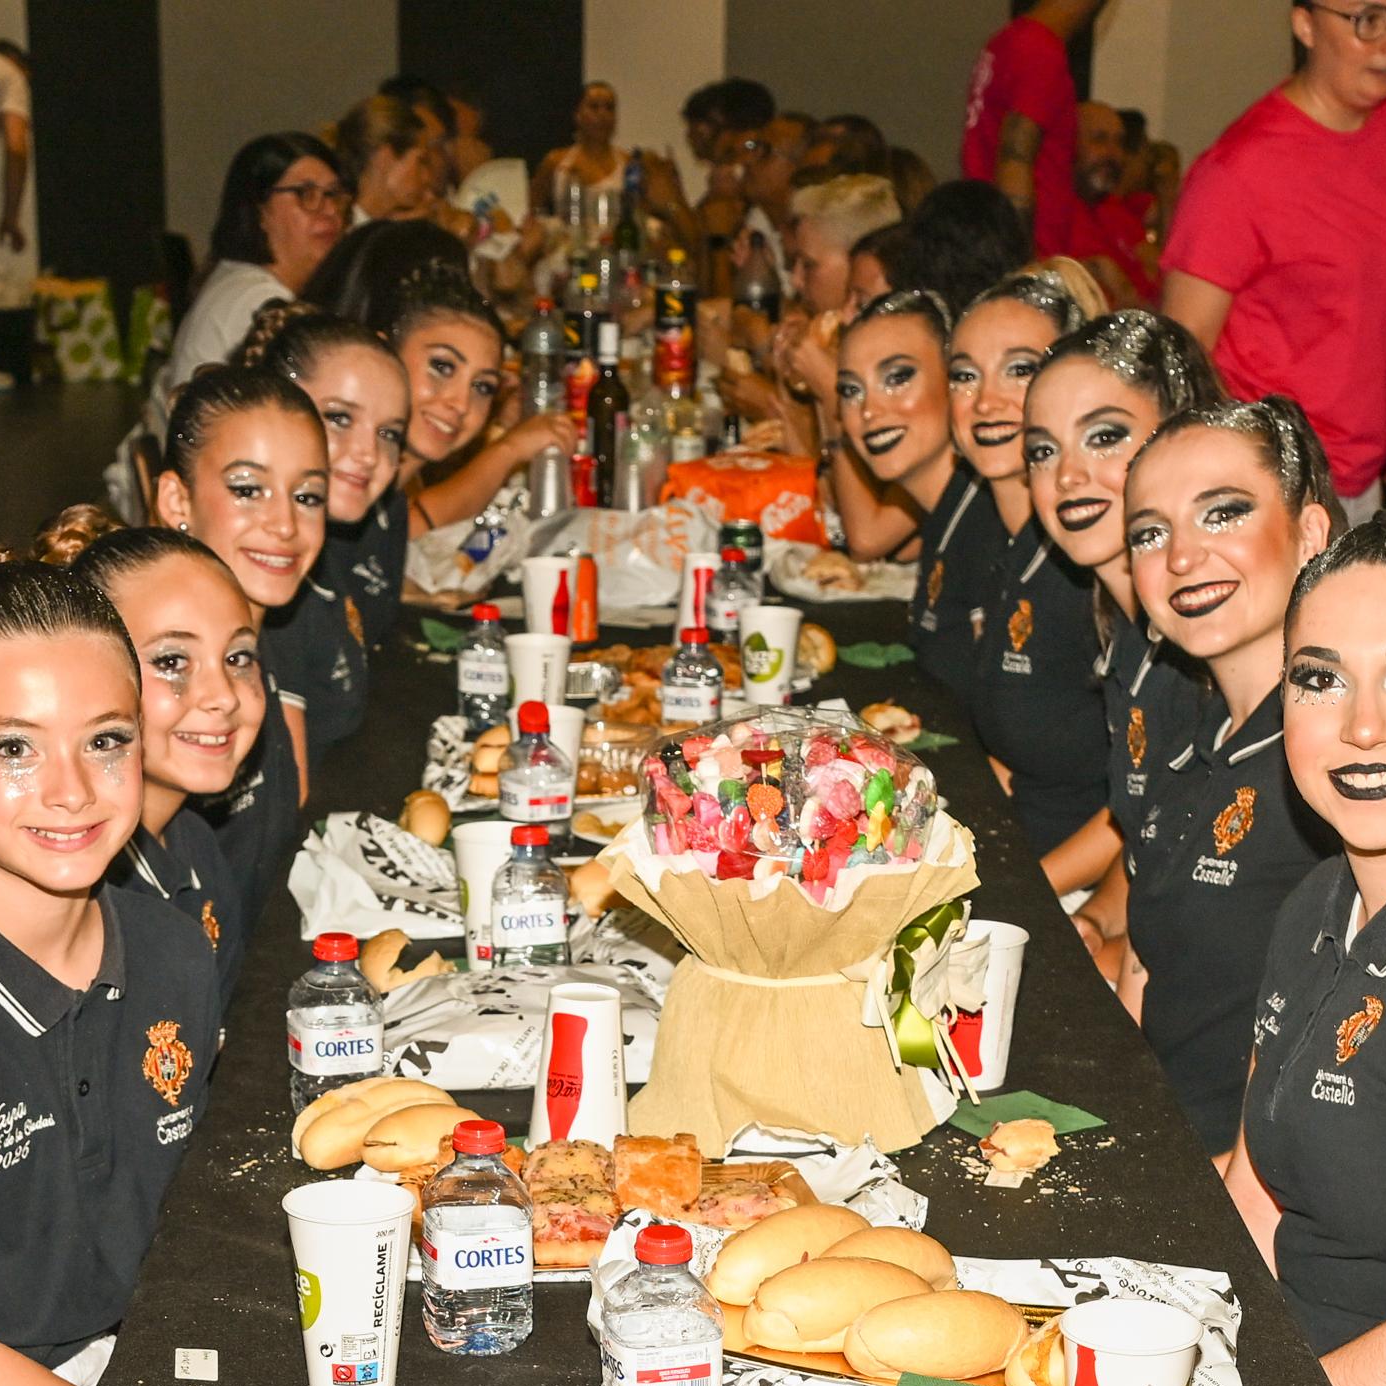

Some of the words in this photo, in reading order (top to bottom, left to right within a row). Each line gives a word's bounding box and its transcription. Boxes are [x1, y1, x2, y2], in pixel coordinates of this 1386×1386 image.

[501, 913, 554, 931] CORTES
[315, 1038, 375, 1057] CORTES
[455, 1246, 525, 1269] CORTES
[373, 1243, 388, 1328] RECÍCLAME
